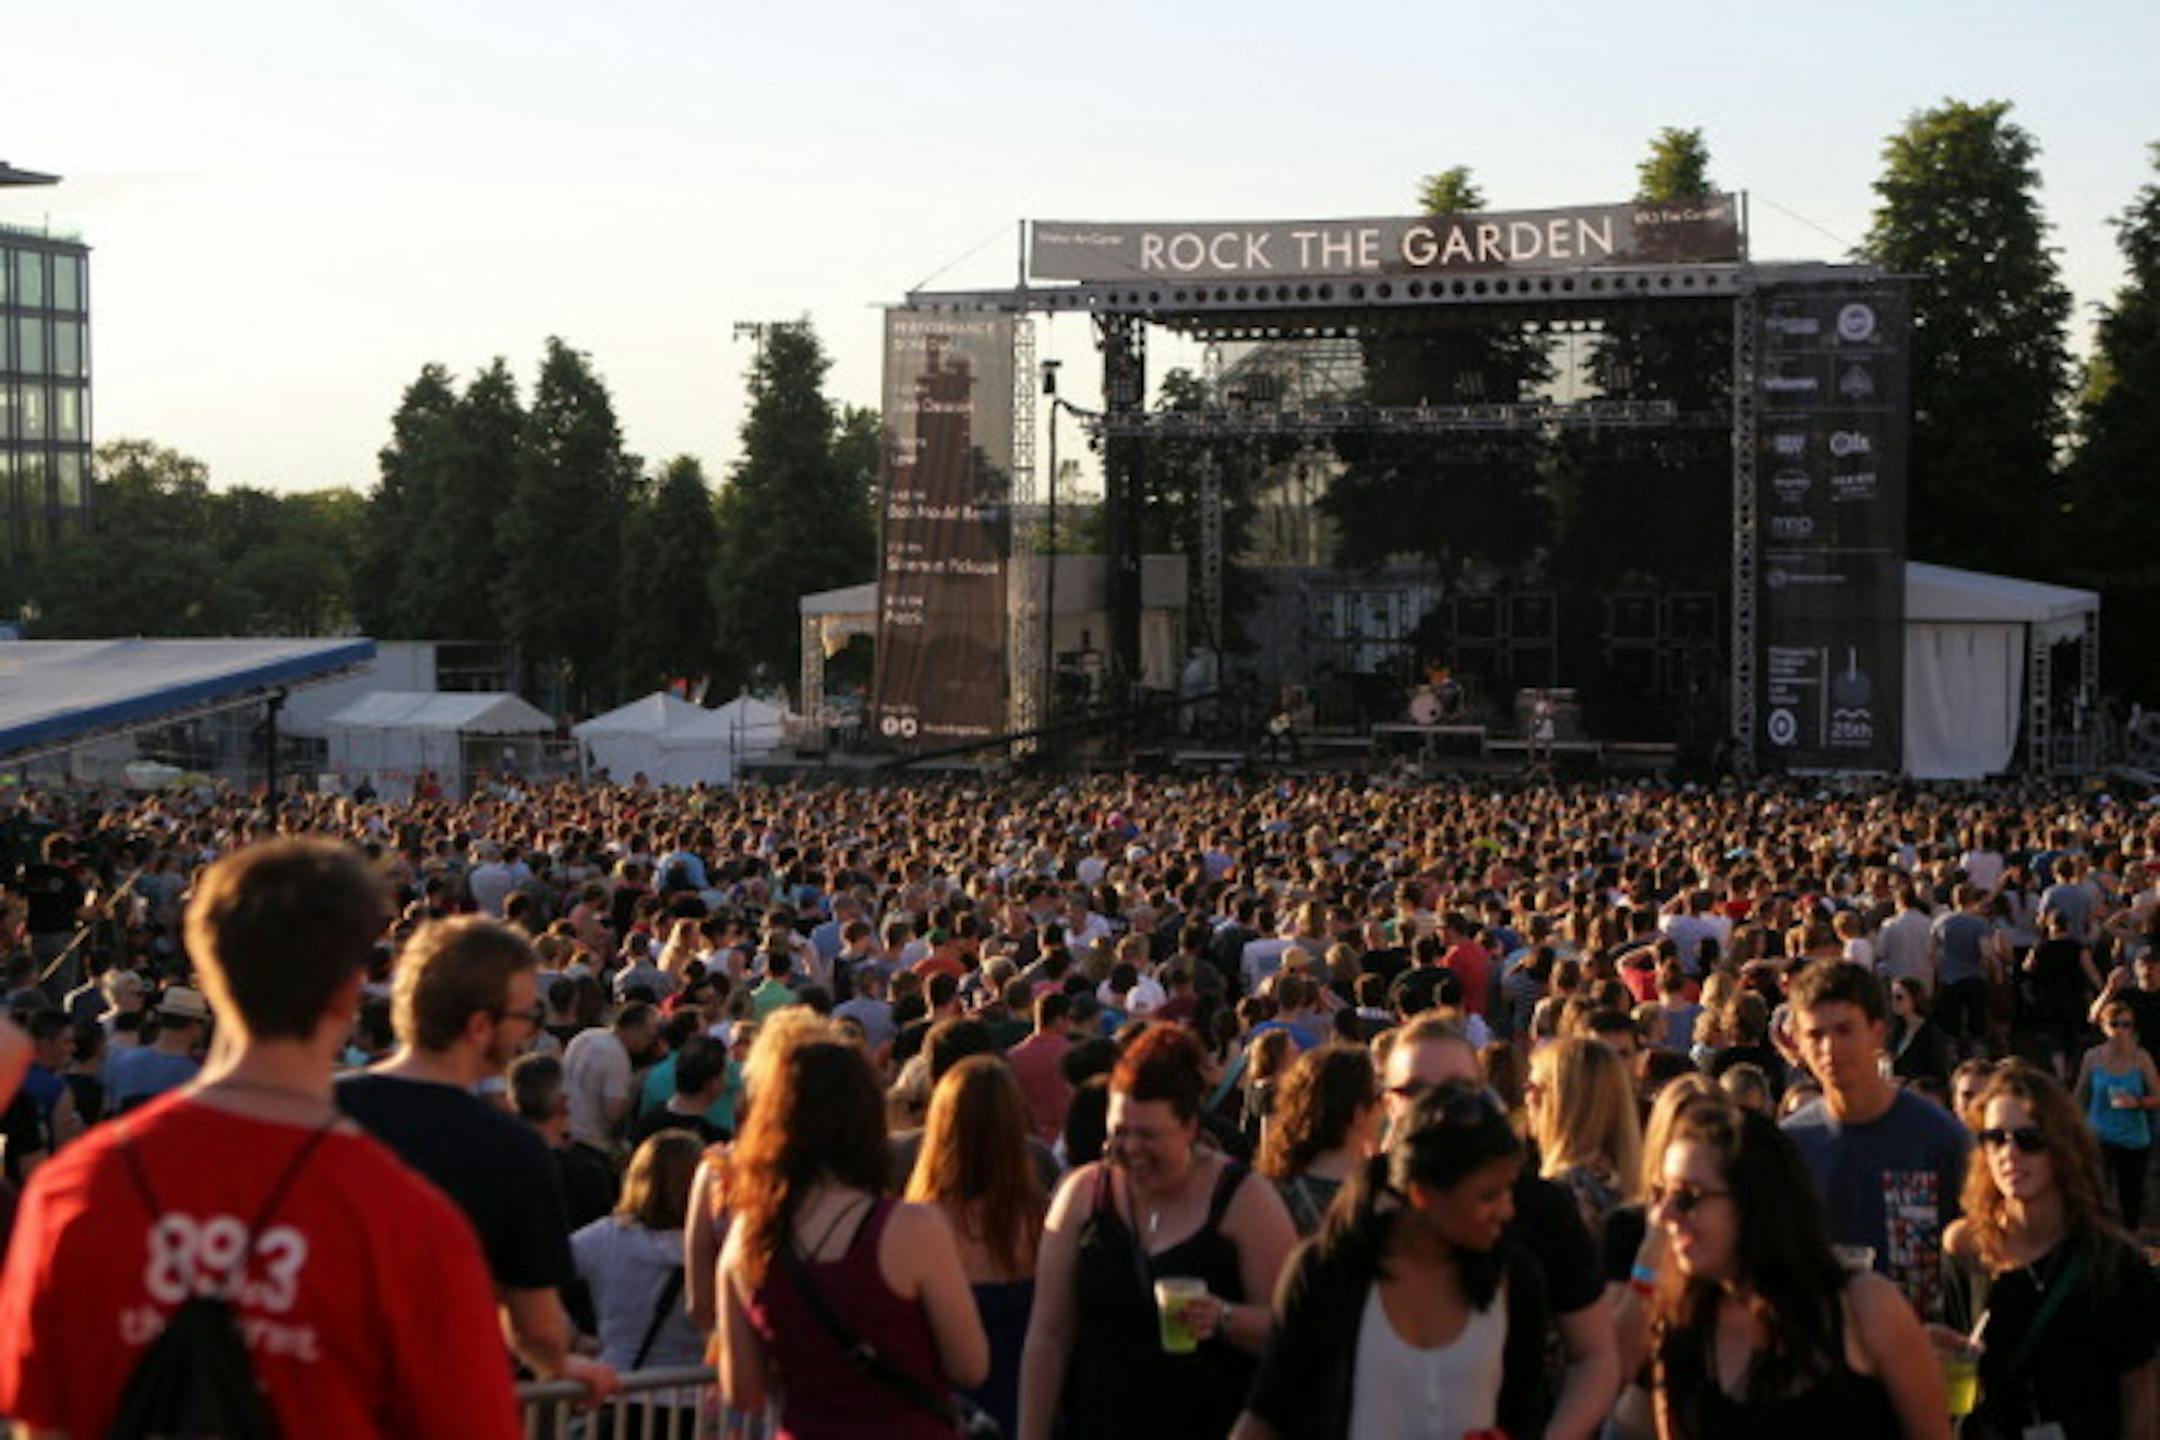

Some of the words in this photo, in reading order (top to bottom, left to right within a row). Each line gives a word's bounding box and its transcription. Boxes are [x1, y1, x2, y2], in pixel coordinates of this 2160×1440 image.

[1140, 231, 1273, 272] ROCK
[1291, 228, 1381, 269] THE
[1402, 215, 1615, 267] GARDEN
